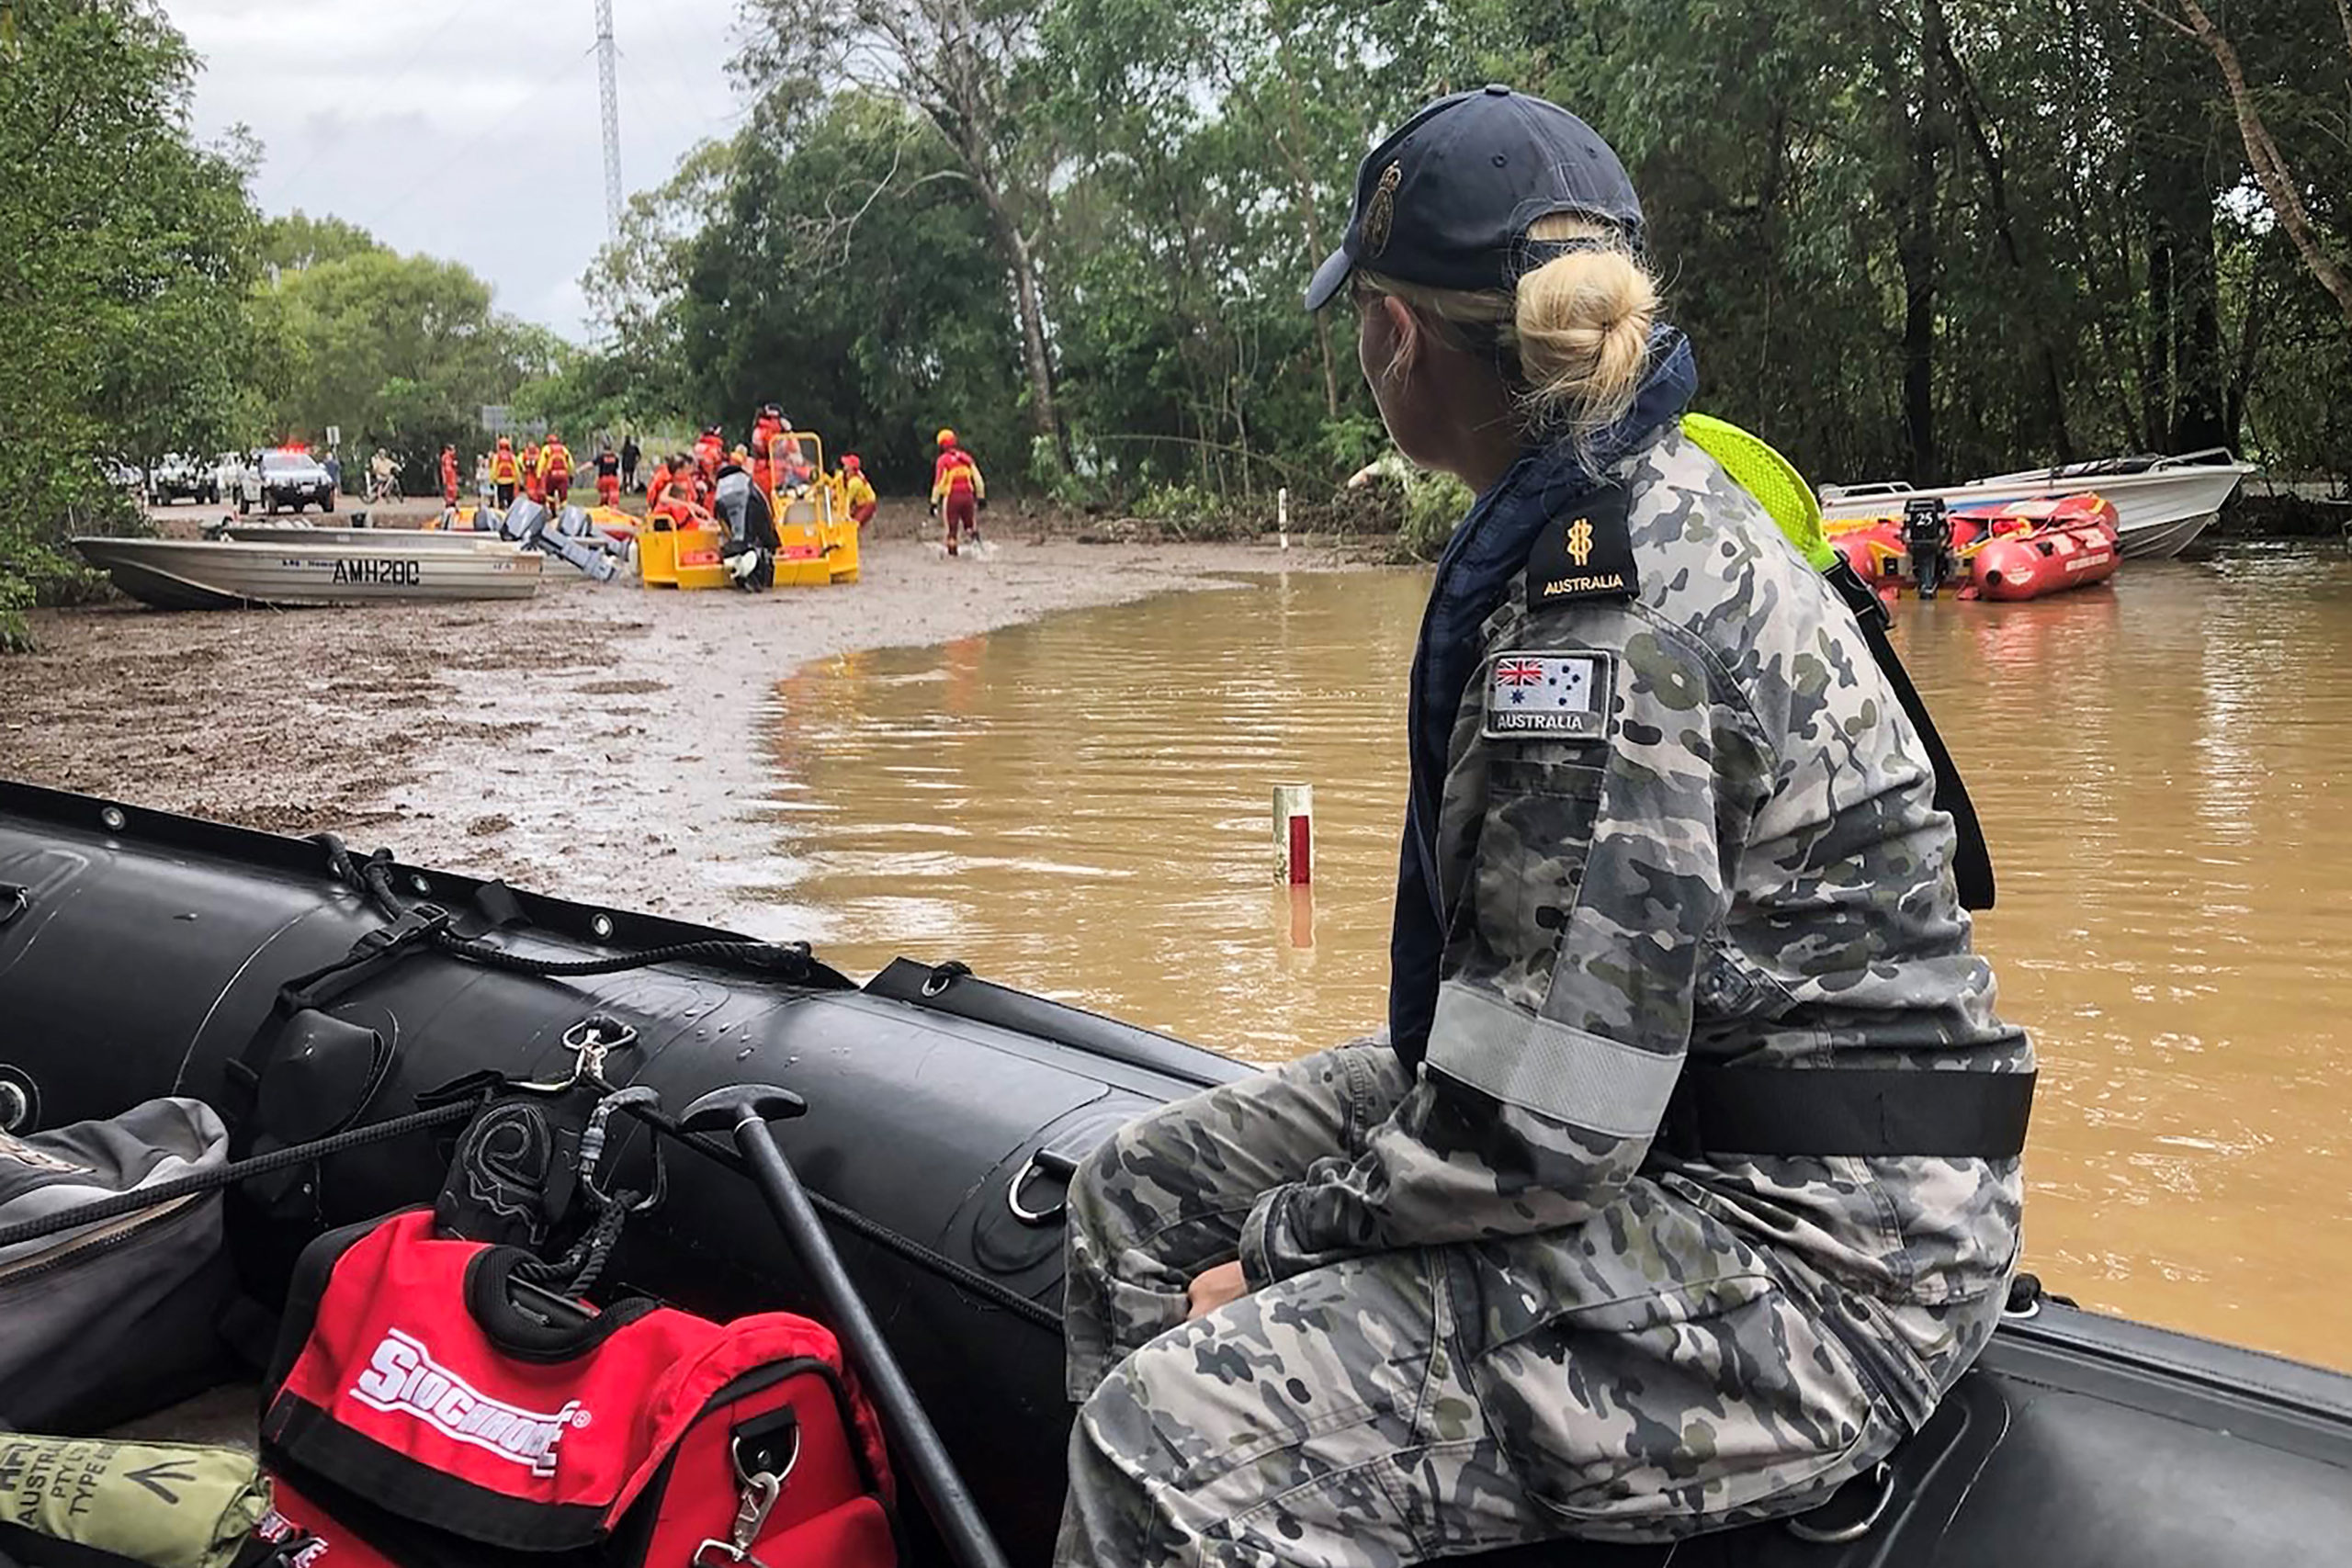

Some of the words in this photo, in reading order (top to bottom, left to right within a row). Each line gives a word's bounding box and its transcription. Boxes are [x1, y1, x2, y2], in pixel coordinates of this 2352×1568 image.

[1916, 513, 1933, 526] 25
[1544, 573, 1623, 596] AUSTRALIA
[1498, 714, 1583, 730] AUSTRALIA
[51, 1463, 73, 1499] PTY
[69, 1462, 106, 1517] TYPE
